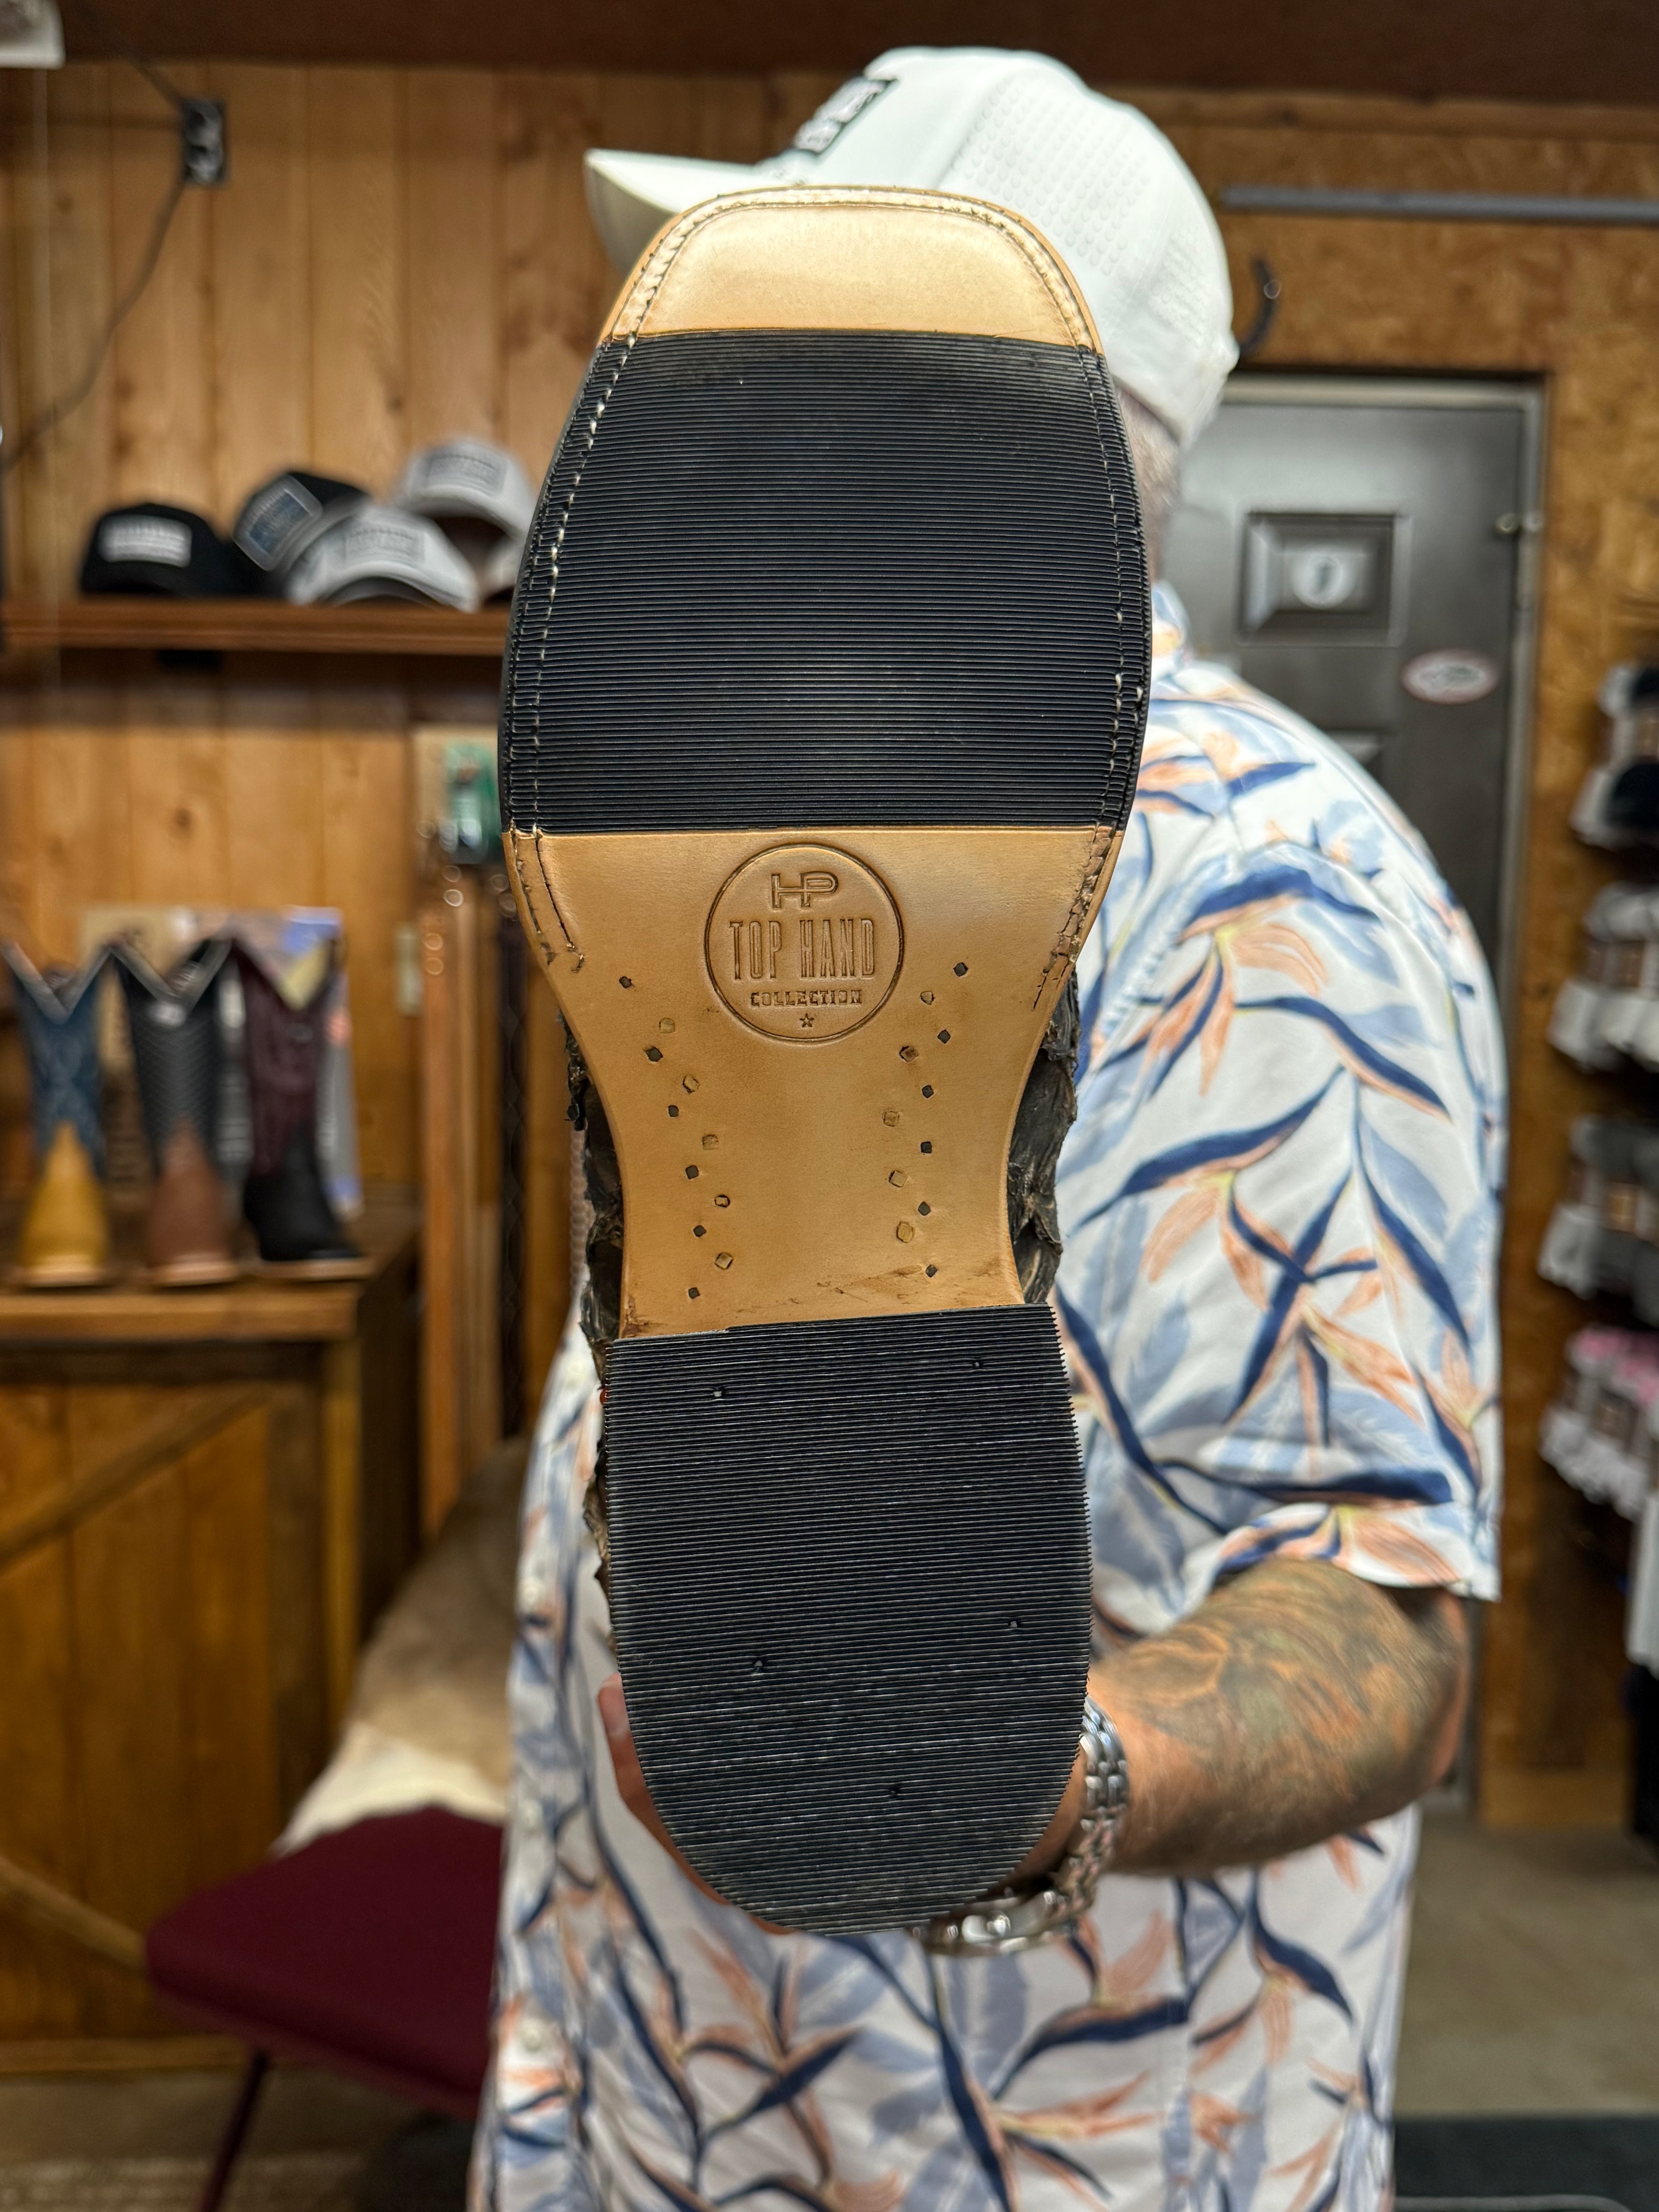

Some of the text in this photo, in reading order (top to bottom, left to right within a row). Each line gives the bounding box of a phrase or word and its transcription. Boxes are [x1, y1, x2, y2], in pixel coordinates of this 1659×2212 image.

[730, 919, 875, 980] TOP HAND
[750, 990, 862, 1007] COLLECTION
